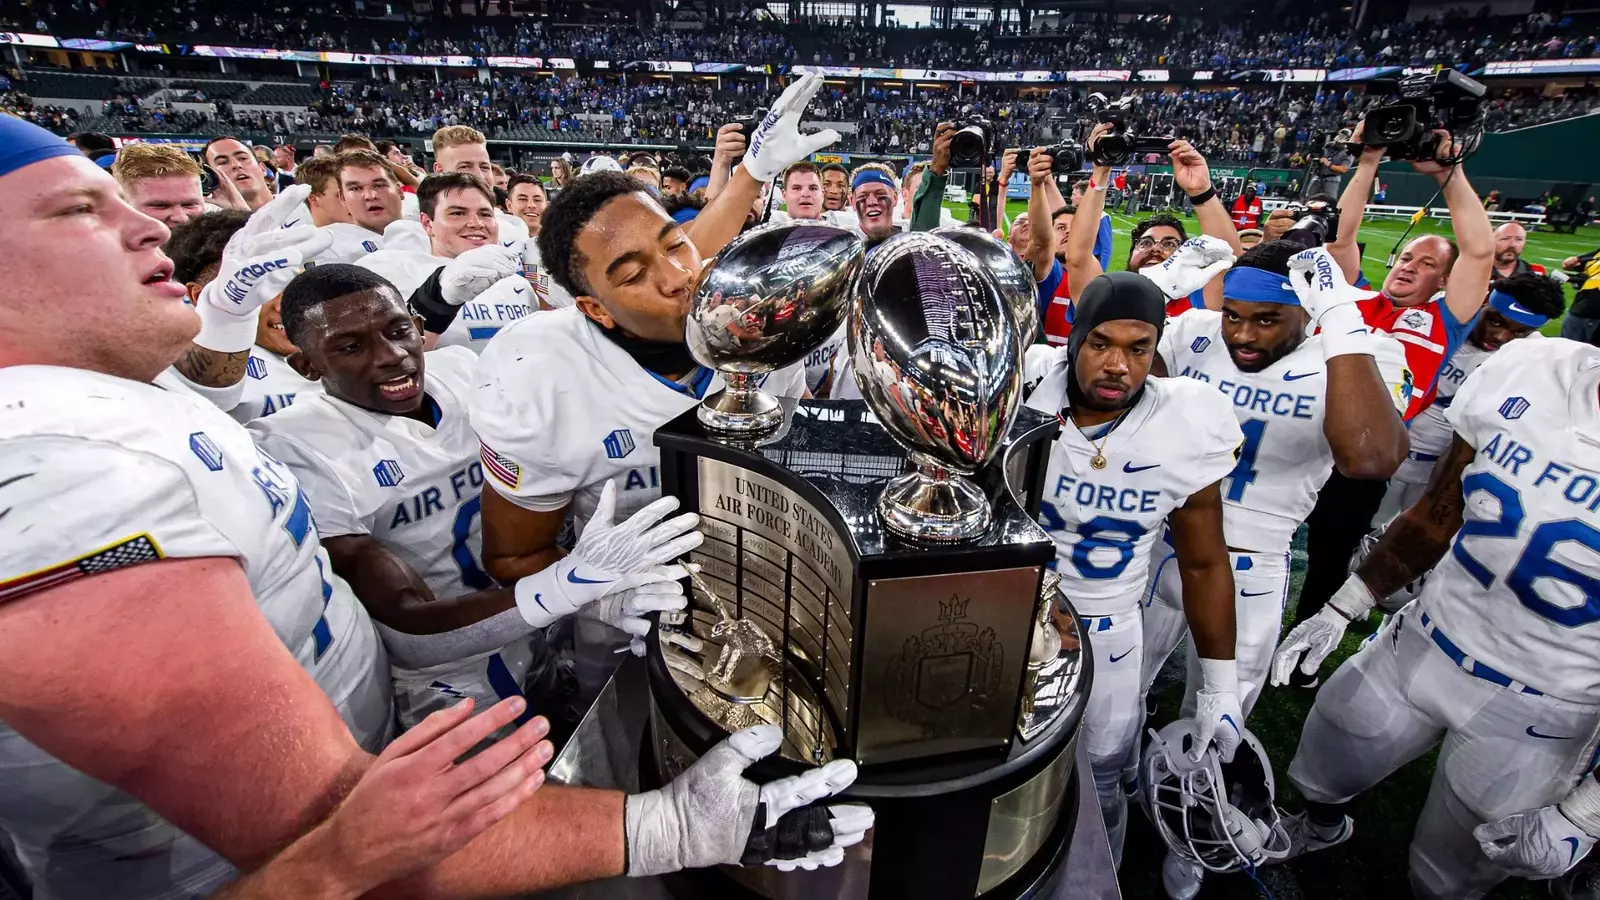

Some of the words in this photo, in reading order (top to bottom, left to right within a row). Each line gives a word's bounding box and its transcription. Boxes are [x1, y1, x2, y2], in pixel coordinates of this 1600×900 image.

[224, 279, 249, 305] AIR
[233, 258, 288, 287] FORCE
[1316, 254, 1334, 291] FORCE
[462, 303, 493, 320] AIR
[494, 304, 531, 321] FORC
[1218, 379, 1317, 420] FORCE
[1054, 473, 1161, 514] FORCE
[1480, 433, 1533, 476] AIR
[1531, 460, 1600, 513] FO
[388, 484, 444, 531] AIR
[735, 476, 789, 514] UNITED
[792, 502, 833, 550] STATES
[715, 494, 742, 516] AIR
[746, 502, 791, 539] FORCE
[794, 531, 844, 591] ACADEMY
[1453, 471, 1600, 628] 26
